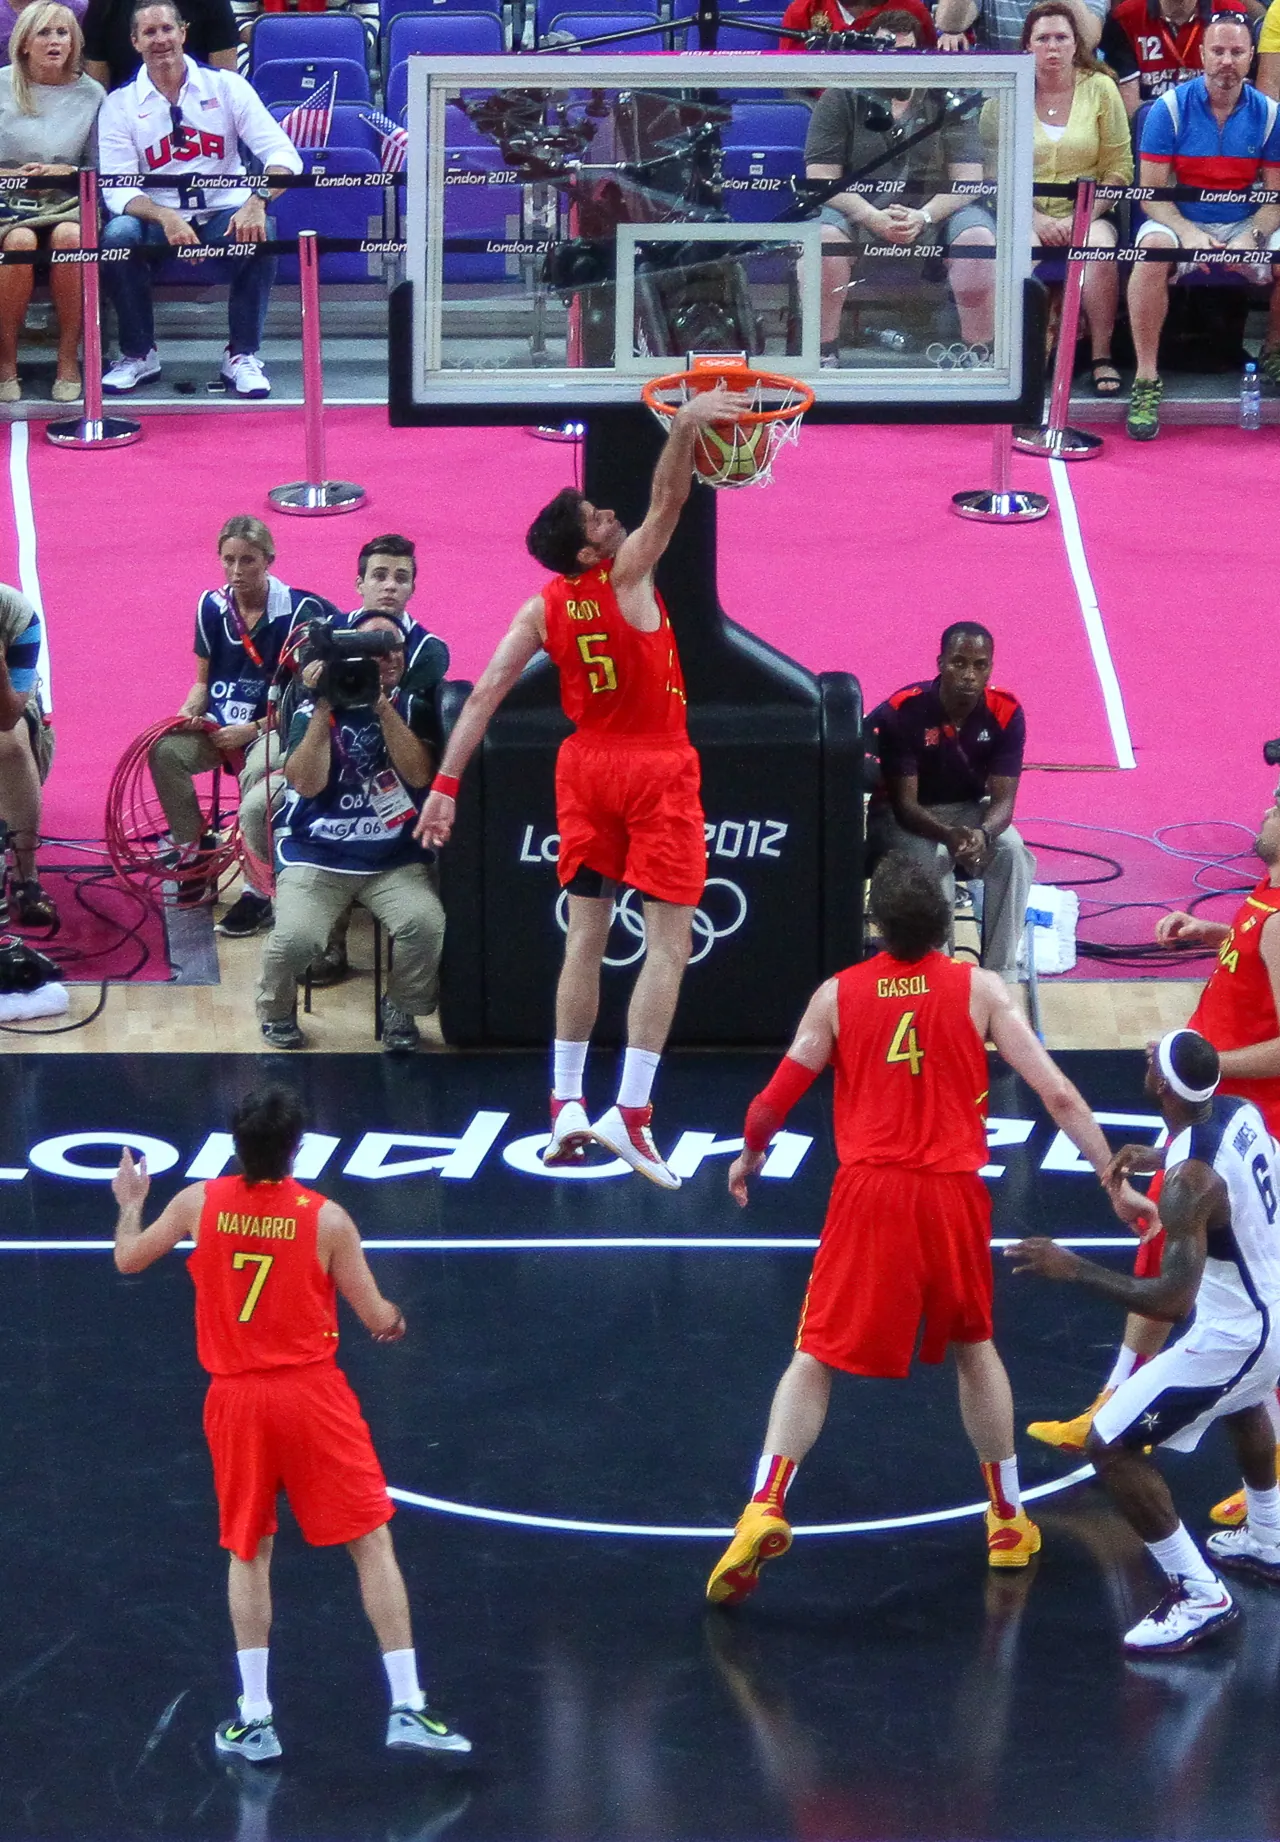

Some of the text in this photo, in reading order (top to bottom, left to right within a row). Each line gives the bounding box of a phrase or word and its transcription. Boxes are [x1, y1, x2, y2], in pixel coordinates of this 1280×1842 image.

[1138, 36, 1163, 60] 12
[145, 127, 224, 170] USA
[0, 178, 28, 189] 2012
[116, 176, 144, 187] 2012
[191, 175, 269, 187] London 2012
[315, 174, 393, 187] London 2012
[489, 172, 517, 183] 2012
[752, 179, 780, 190] 2012
[876, 181, 906, 193] 2012
[952, 182, 996, 194] London
[1127, 188, 1154, 200] 2012
[1201, 190, 1278, 203] London 2012
[177, 244, 256, 257] London 2012
[360, 241, 407, 252] London
[487, 241, 533, 252] London
[864, 244, 943, 257] London 2012
[52, 249, 130, 262] London 2012
[1068, 249, 1146, 261] London 2012
[1193, 251, 1272, 263] London 2012
[577, 633, 618, 694] 5
[878, 975, 930, 997] GASOL
[887, 1011, 924, 1075] 4
[1252, 1153, 1277, 1225] 6
[217, 1211, 297, 1240] NAVARRO
[233, 1252, 273, 1322] 7
